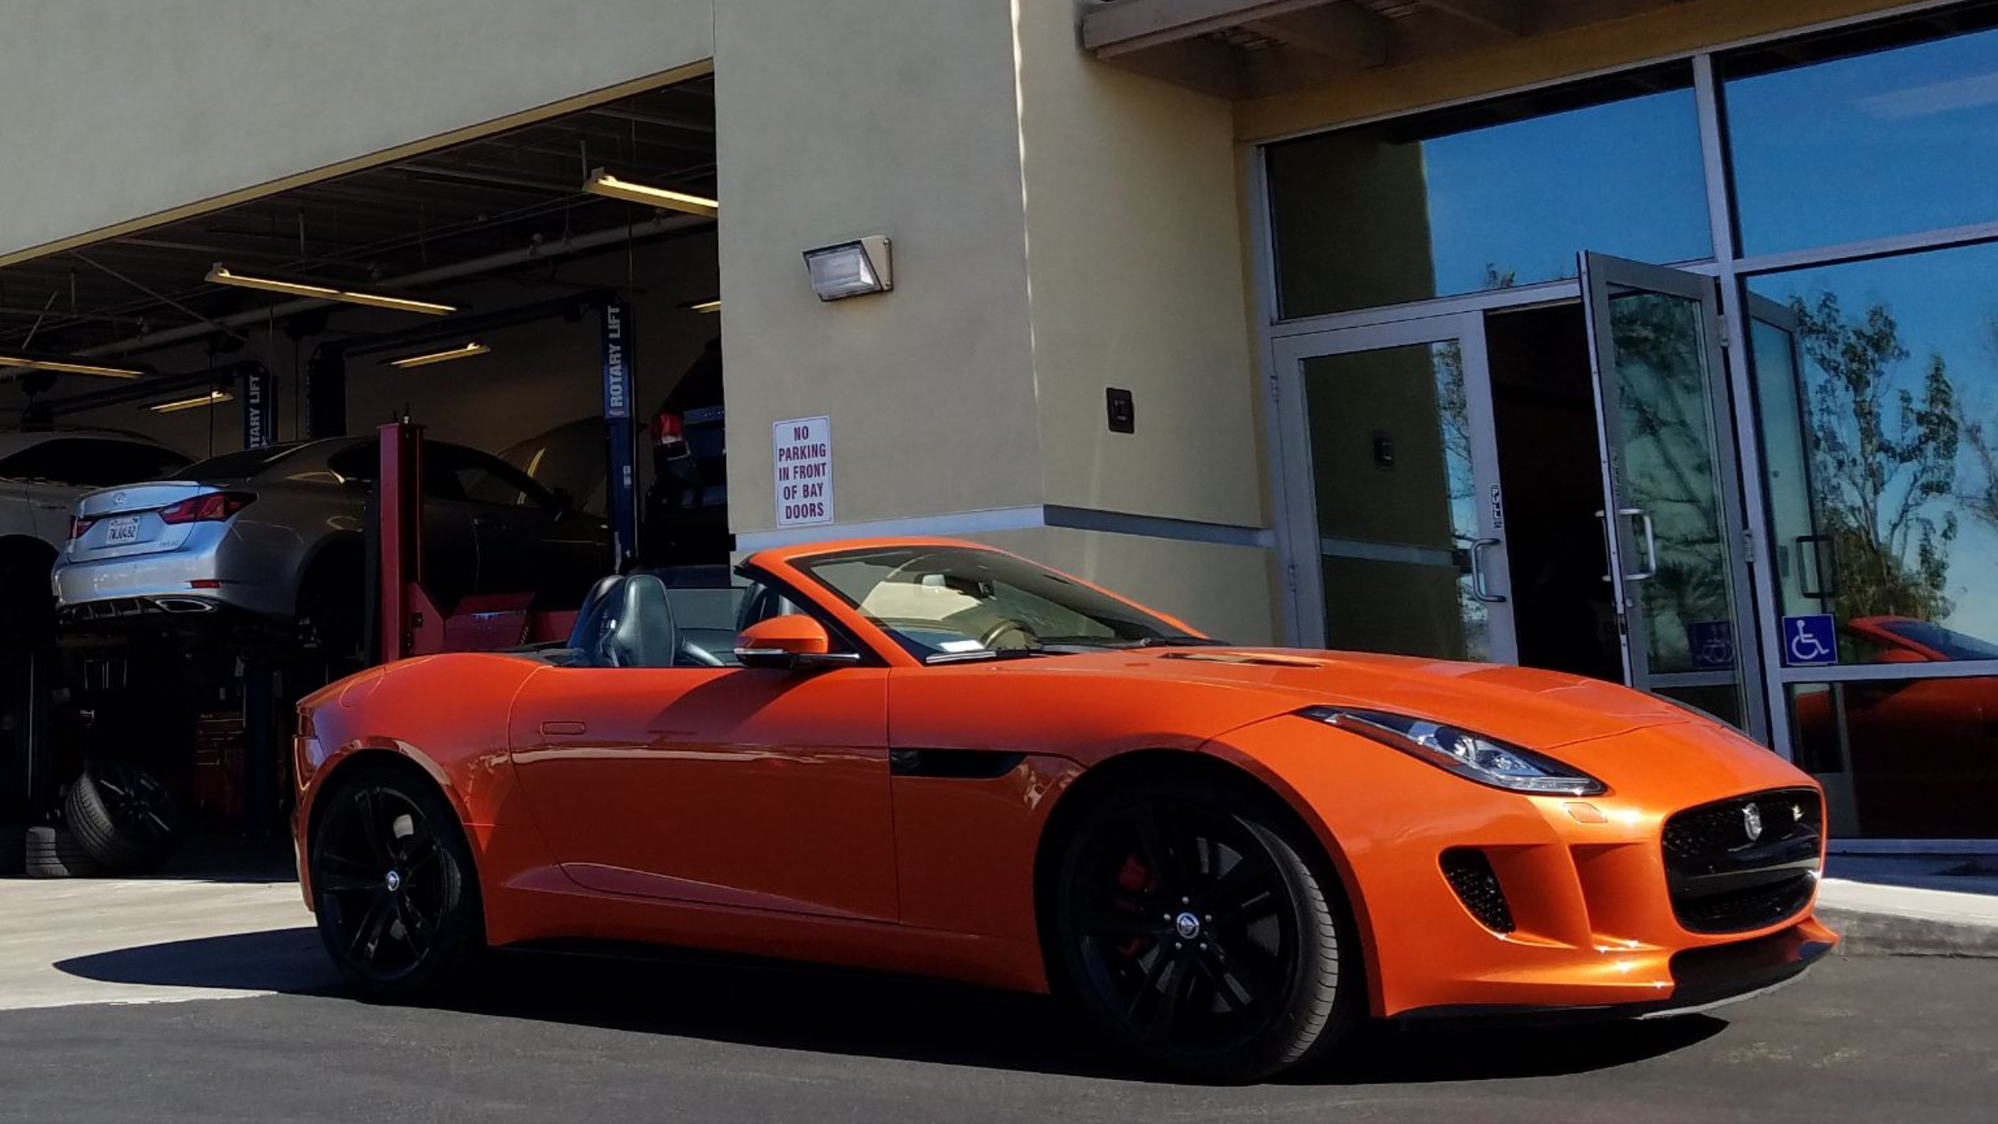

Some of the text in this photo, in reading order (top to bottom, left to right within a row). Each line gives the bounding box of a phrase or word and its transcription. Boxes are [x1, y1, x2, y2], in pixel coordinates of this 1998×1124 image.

[608, 305, 623, 407] ROTARY LIFT
[249, 373, 261, 404] LIFT
[793, 426, 809, 441] NO
[778, 443, 826, 462] PARKING
[778, 462, 827, 481] IN FRONT
[783, 482, 823, 500] OF BAY
[785, 502, 824, 519] DOORS
[1491, 488, 1501, 519] PULL
